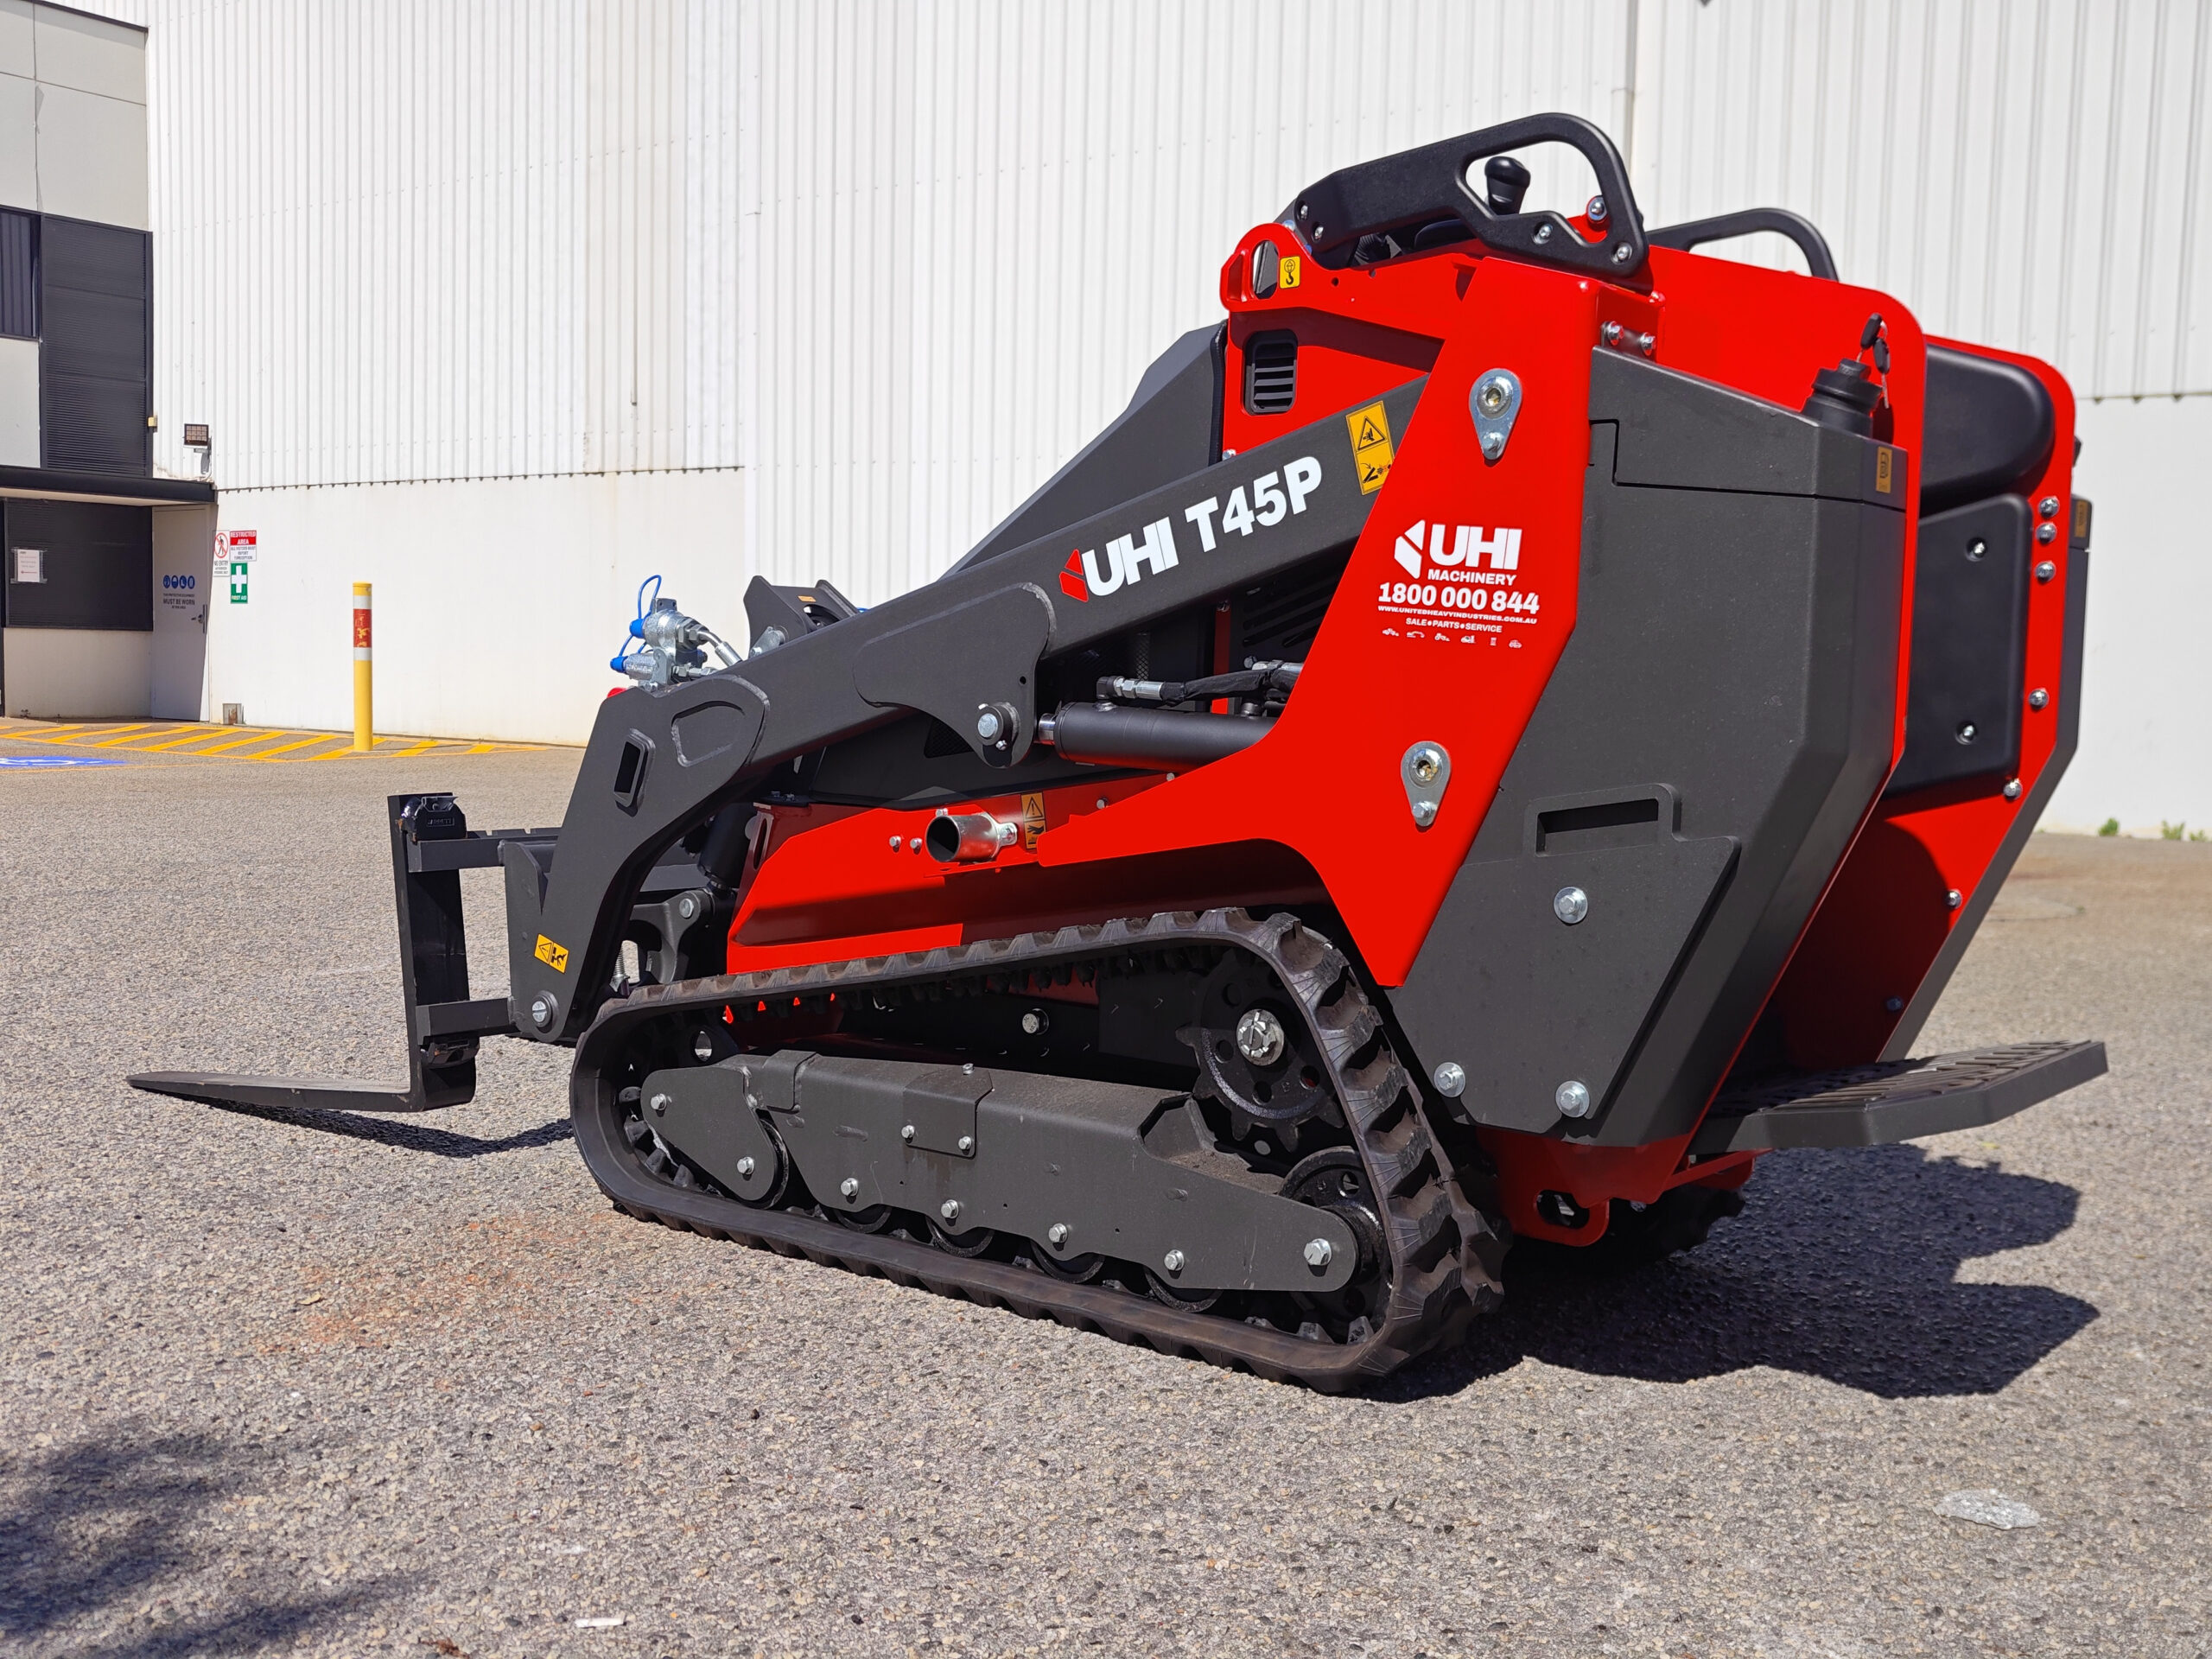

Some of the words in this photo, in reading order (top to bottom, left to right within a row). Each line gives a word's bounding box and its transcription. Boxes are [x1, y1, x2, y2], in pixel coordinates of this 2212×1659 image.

[1081, 517, 1179, 596] UHI
[1184, 456, 1323, 553] T45P
[1428, 523, 1522, 570] UHI
[1427, 569, 1517, 587] MACHINERY
[1377, 582, 1437, 607] 1800
[1440, 586, 1488, 610] 000
[1491, 589, 1541, 614] 844
[1377, 605, 1538, 625] WWW.UNITEDHEAVYINDUSTRIES.COM.AU
